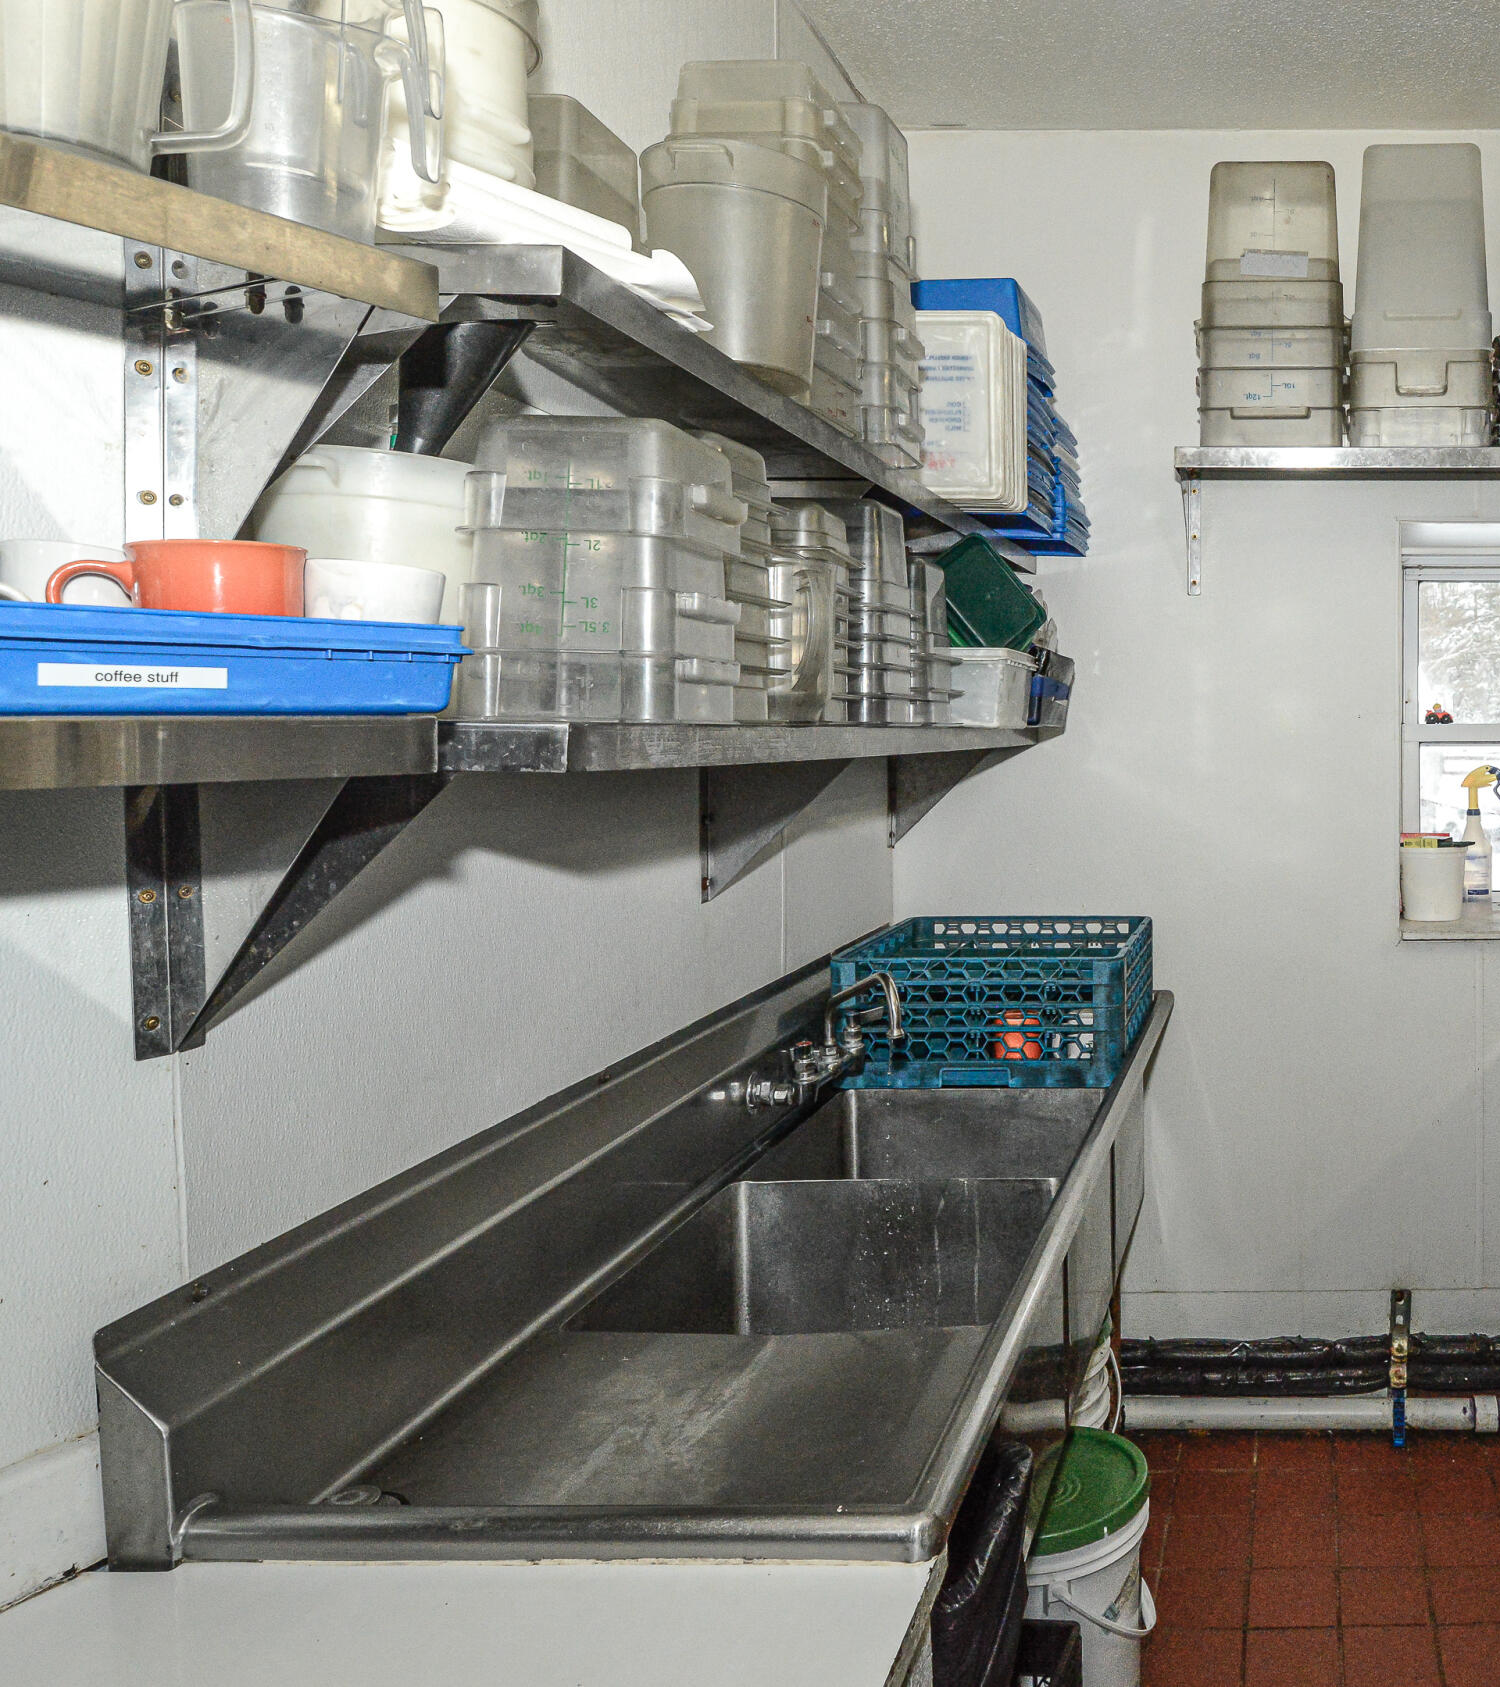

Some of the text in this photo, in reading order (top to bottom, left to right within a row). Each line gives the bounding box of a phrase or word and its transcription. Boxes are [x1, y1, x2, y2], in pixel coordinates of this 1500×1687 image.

[584, 539, 600, 551] 2L
[518, 584, 598, 608] 3qt. 3L
[95, 670, 179, 683] coffee stuff
